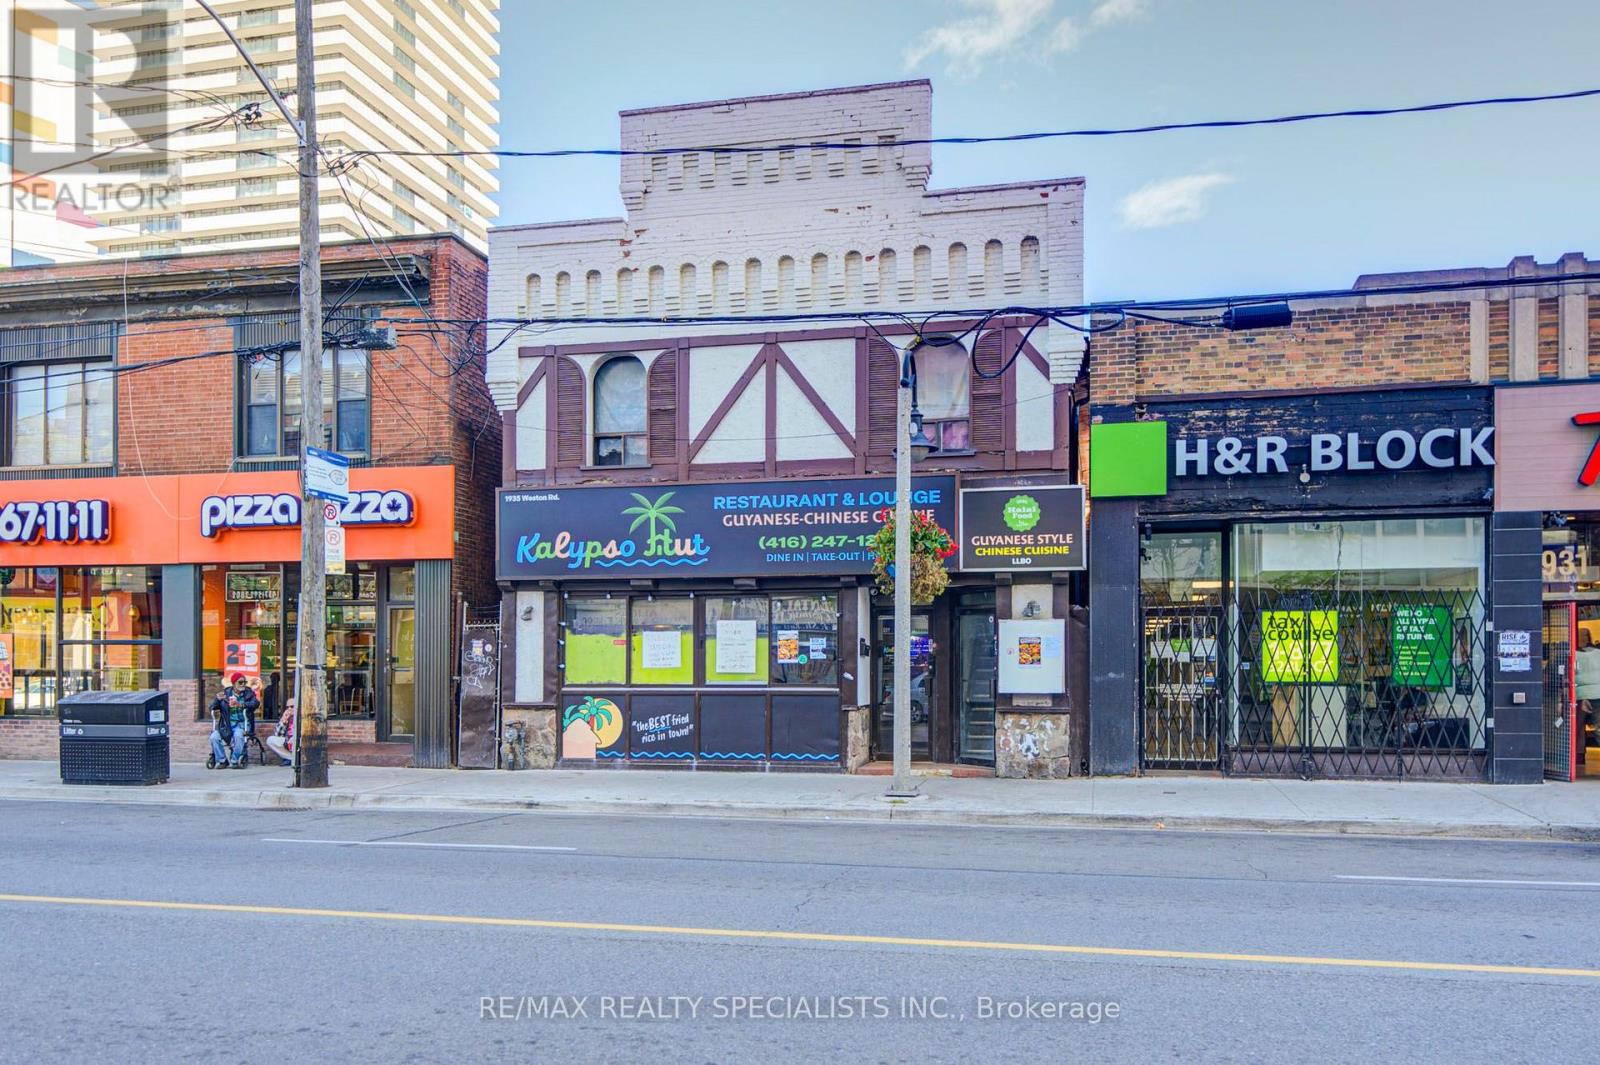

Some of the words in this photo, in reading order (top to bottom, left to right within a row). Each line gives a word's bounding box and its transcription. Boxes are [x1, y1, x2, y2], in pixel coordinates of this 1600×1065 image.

[1176, 437, 1289, 475] H&R
[1311, 427, 1496, 471] BLOCK
[713, 493, 838, 510] RESTAURANT
[842, 491, 855, 506] &
[859, 490, 941, 506] LOUGE
[202, 494, 298, 537] pizza
[722, 510, 868, 527] GUYANESE-CHINESE
[758, 536, 807, 550] (416)
[811, 534, 879, 549] 247-12
[971, 534, 1034, 546] GUYANESE
[1037, 533, 1074, 544] STYLE
[516, 531, 635, 568] Kalypso
[643, 528, 710, 557] Hut
[975, 546, 1022, 556] CHINESE
[1024, 545, 1070, 555] CUISINE
[766, 552, 790, 562] DINE
[793, 552, 804, 561] IN
[812, 551, 860, 561] TAKE-OUT
[1011, 557, 1032, 565] LLBO
[1267, 629, 1334, 641] couse
[648, 713, 672, 730] BEST
[671, 713, 689, 726] fried
[62, 727, 76, 735] Litter
[147, 726, 160, 735] Litter
[641, 732, 656, 744] rice
[657, 731, 666, 741] in
